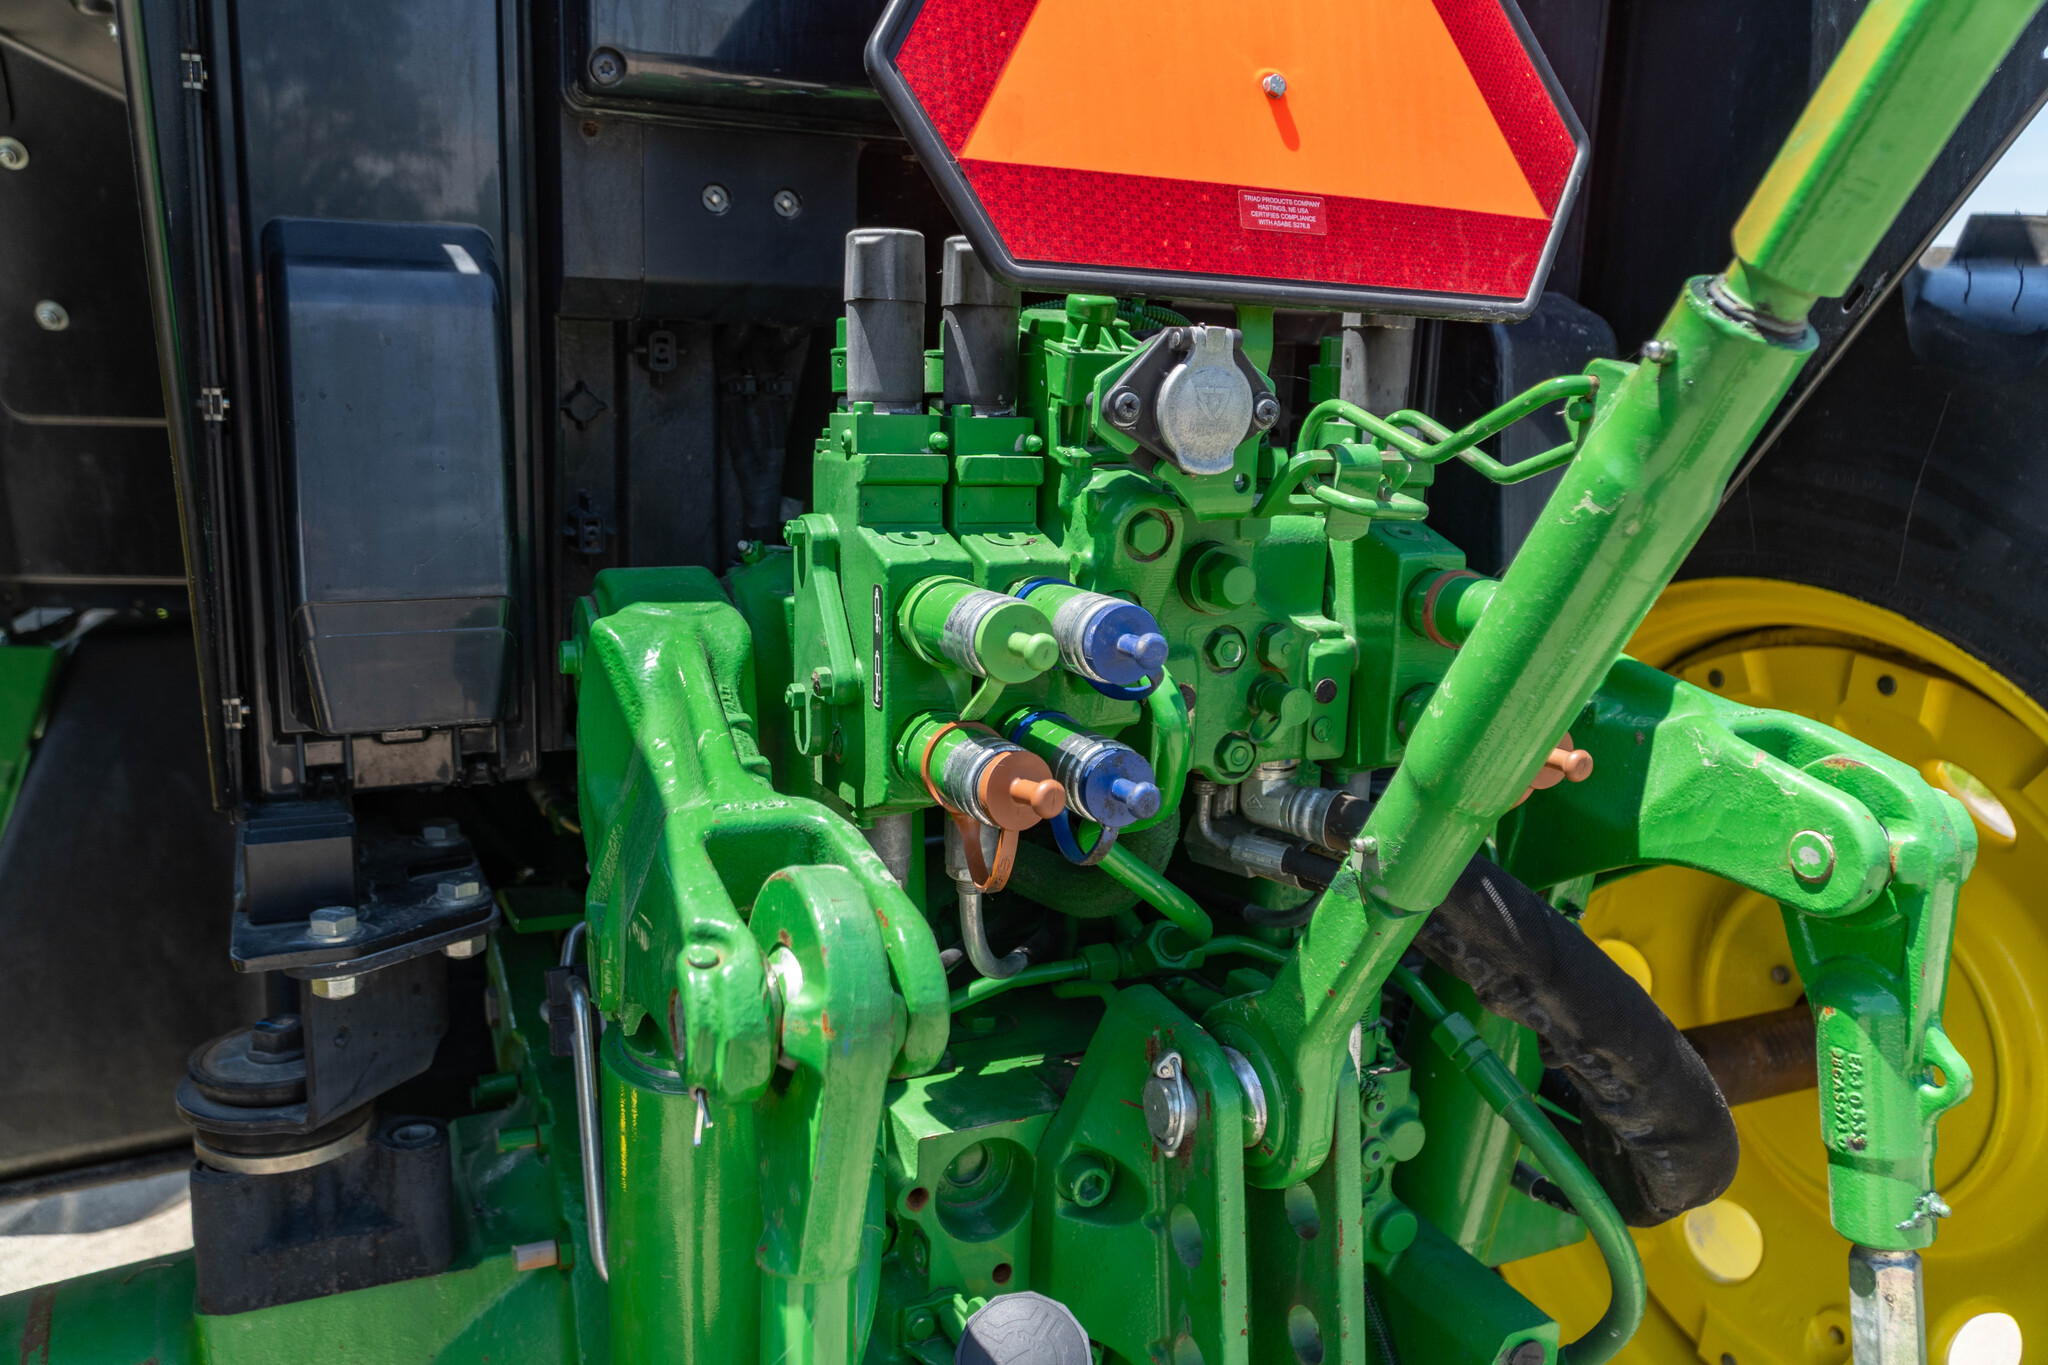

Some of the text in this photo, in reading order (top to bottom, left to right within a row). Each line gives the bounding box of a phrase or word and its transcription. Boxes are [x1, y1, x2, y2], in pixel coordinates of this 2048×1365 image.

[1262, 197, 1292, 205] PRODUCTS
[1294, 200, 1321, 208] COMPANY
[1251, 211, 1316, 222] CERTIFIES COMPLIANCE
